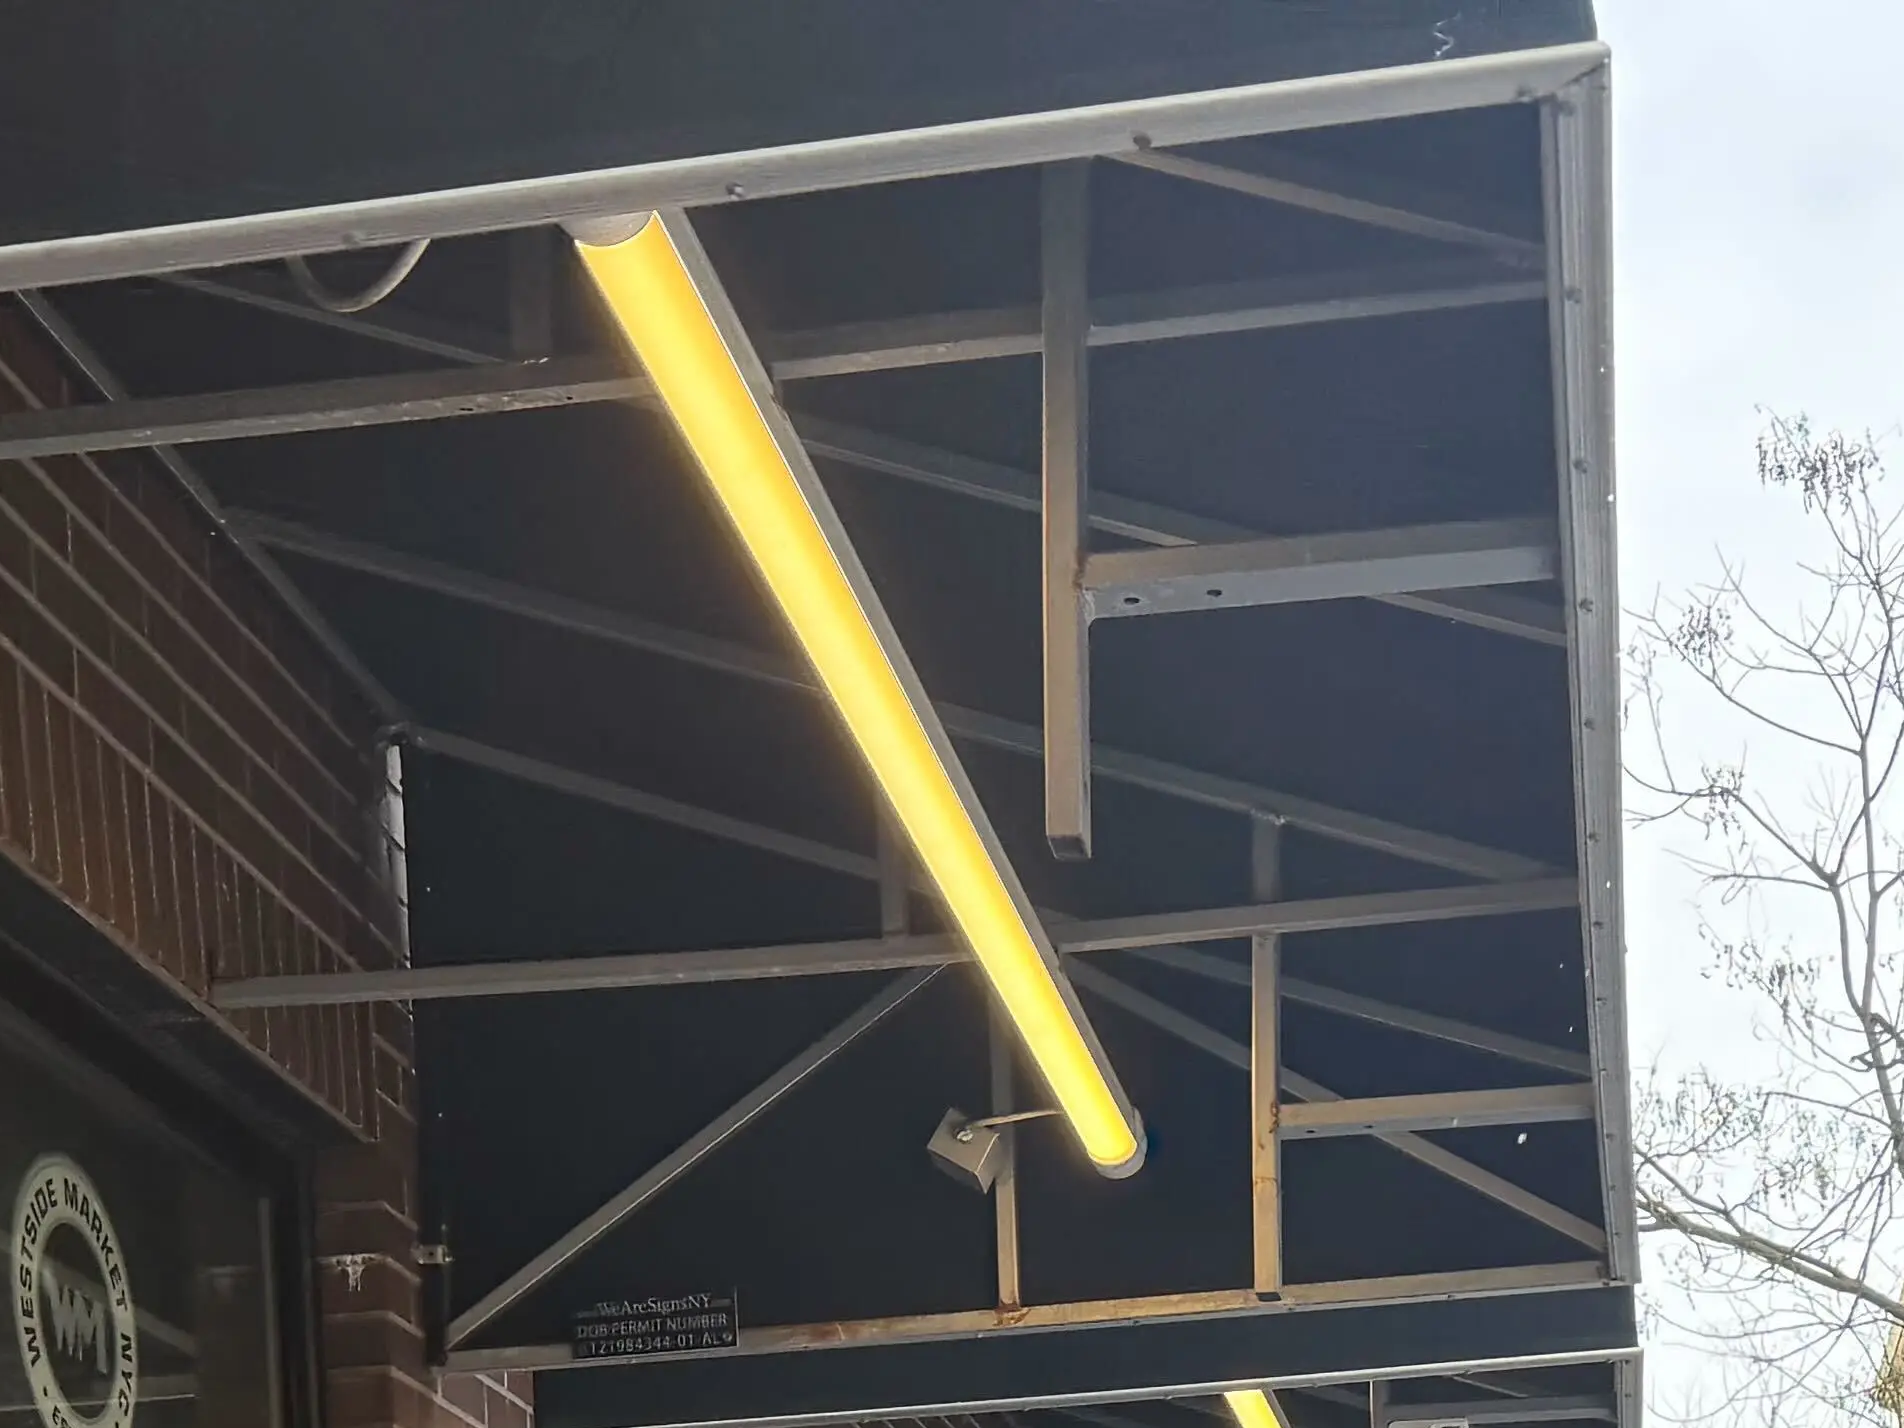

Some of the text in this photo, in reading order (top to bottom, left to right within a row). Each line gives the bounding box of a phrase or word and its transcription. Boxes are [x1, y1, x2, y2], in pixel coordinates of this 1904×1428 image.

[18, 1176, 134, 1417] WESTSIDE MARKET NYC
[611, 1317, 663, 1337] PERMIT
[666, 1312, 727, 1332] NUMBER
